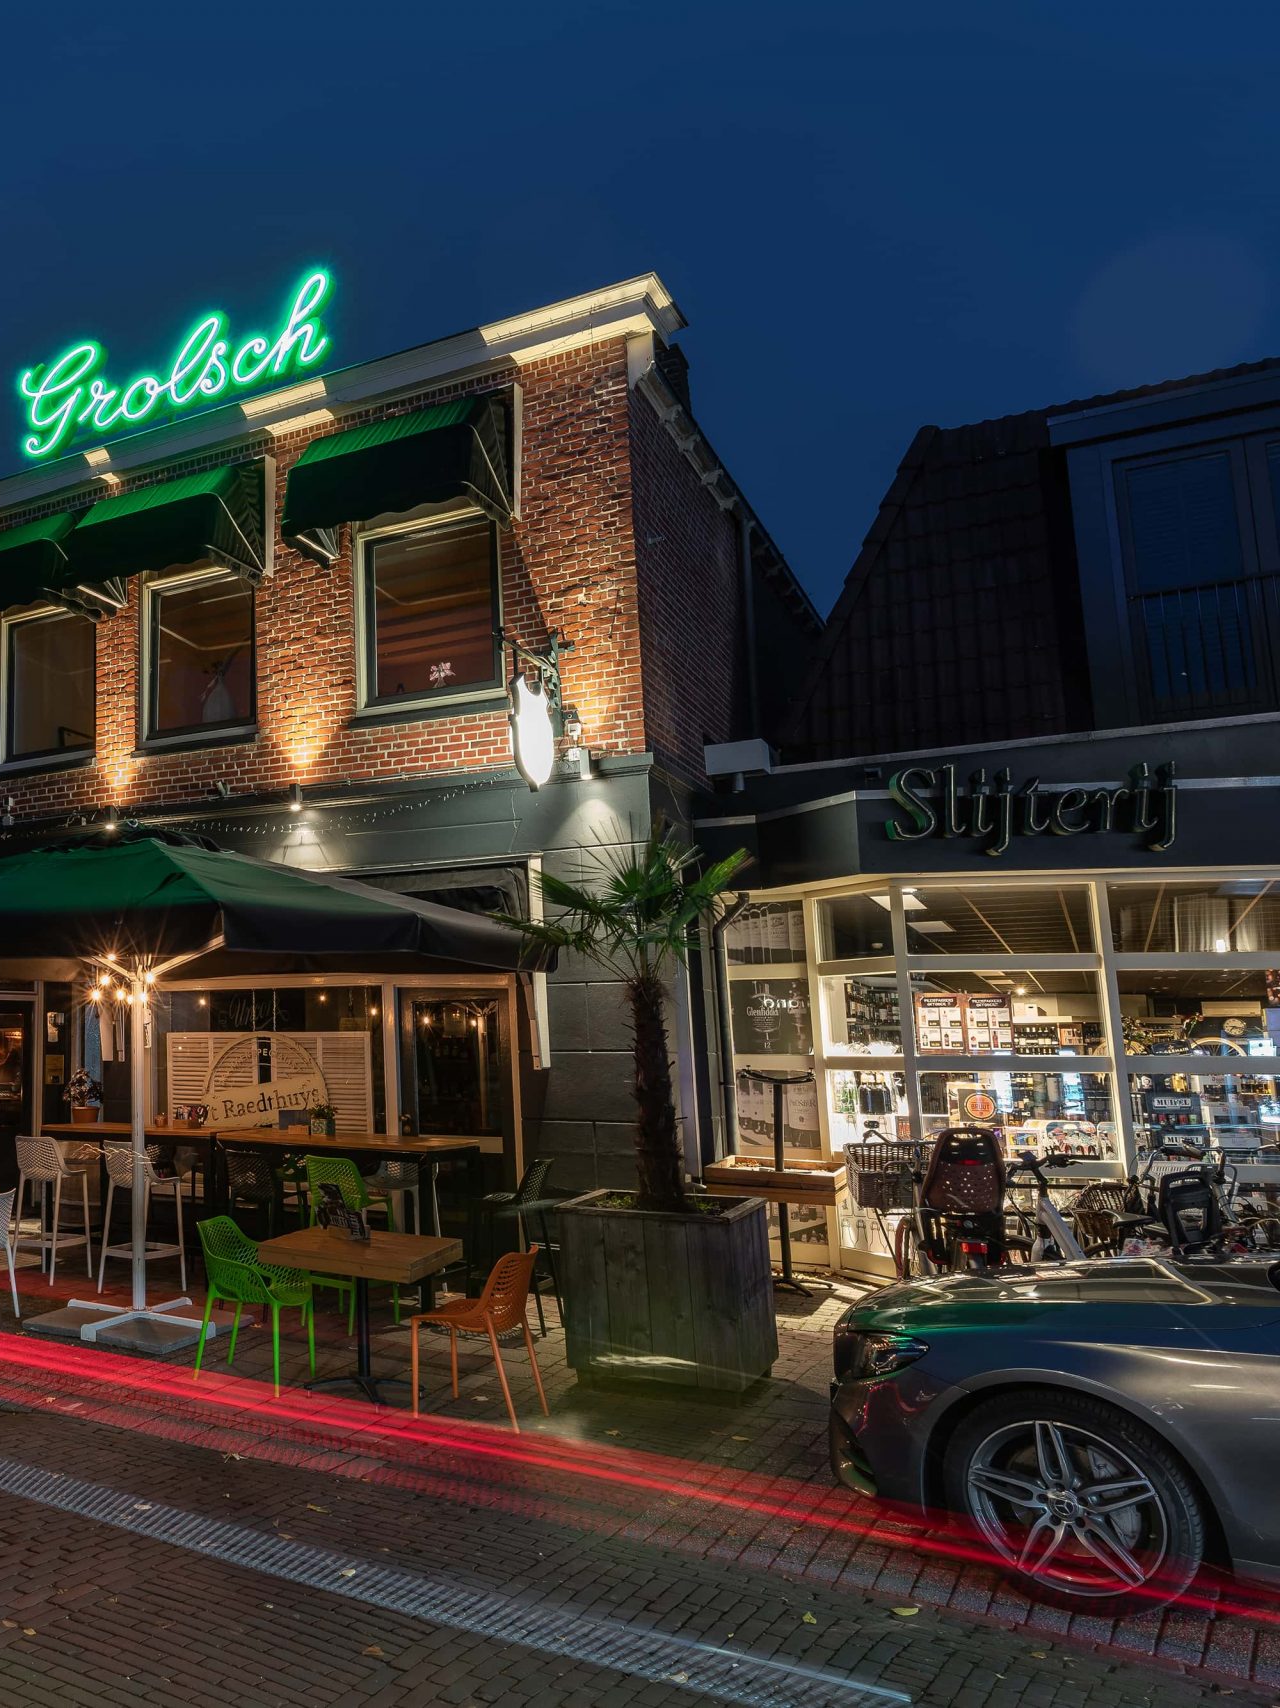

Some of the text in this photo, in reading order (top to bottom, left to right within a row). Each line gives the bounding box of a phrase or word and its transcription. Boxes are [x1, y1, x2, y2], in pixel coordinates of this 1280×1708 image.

[21, 272, 328, 456] Grolsch
[885, 761, 1178, 855] Slijterij
[222, 1089, 320, 1119] Raedthuys
